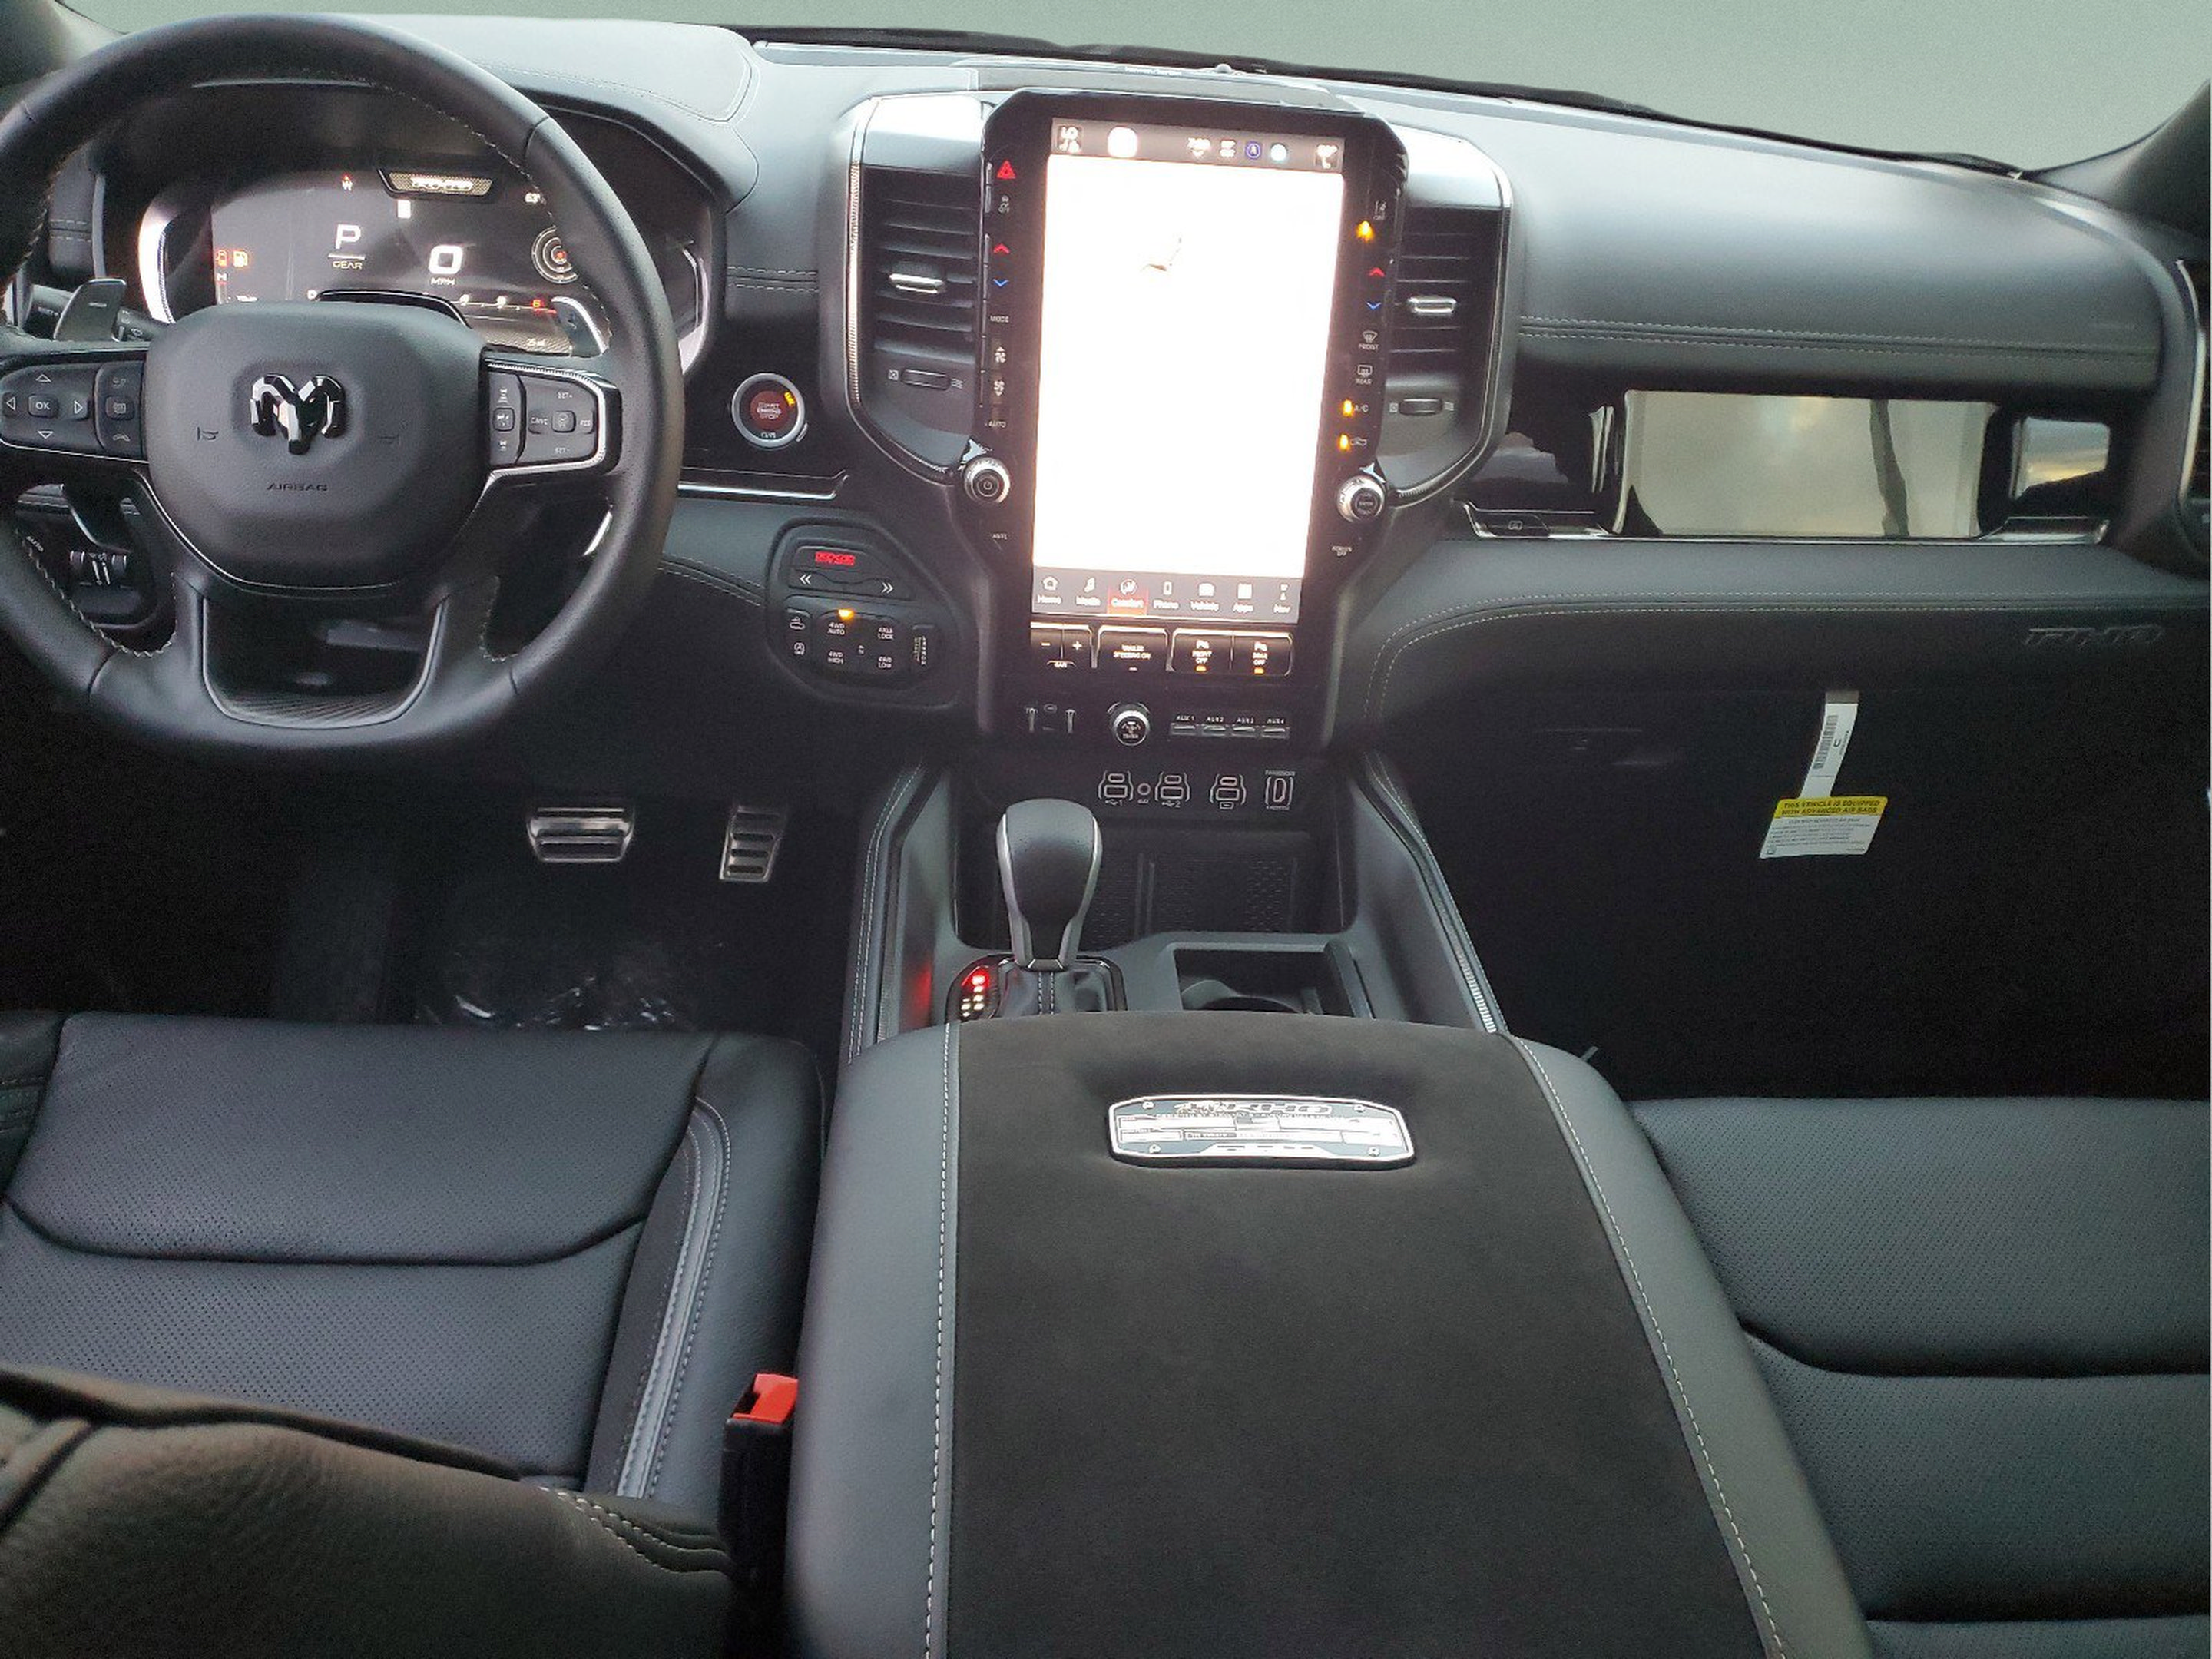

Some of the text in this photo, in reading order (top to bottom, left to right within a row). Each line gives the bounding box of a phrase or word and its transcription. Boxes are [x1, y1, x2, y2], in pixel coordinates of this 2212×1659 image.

[335, 224, 362, 250] P
[332, 260, 363, 270] GEAR
[35, 402, 51, 411] OK
[266, 482, 329, 492] AIRBAG
[1037, 594, 1062, 605] Home
[1153, 599, 1180, 610] Phone
[1175, 800, 1181, 808] 2
